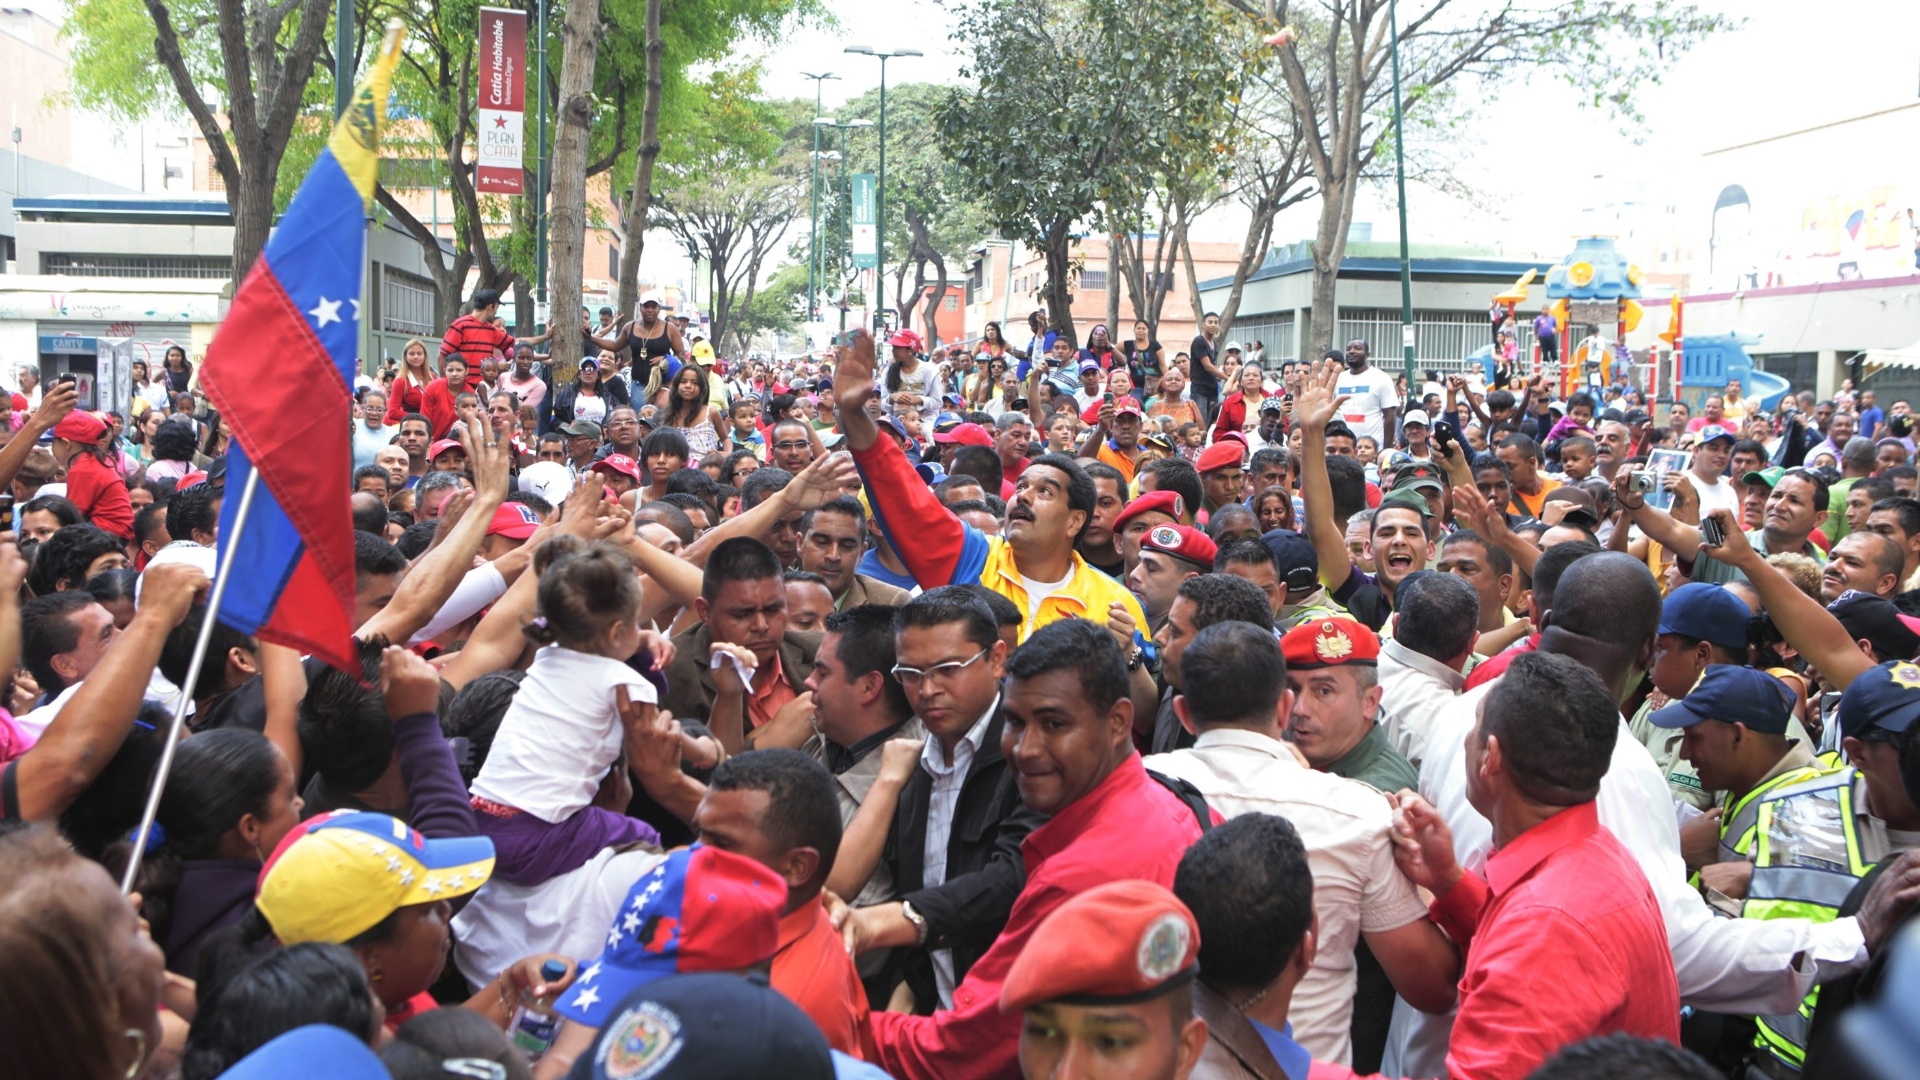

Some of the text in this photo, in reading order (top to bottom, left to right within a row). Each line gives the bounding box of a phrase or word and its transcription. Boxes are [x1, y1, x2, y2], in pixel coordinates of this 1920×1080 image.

[490, 19, 504, 105] Catia Habitable
[505, 56, 513, 77] Digna
[487, 131, 515, 144] PLAN
[483, 144, 518, 158] CATIA
[52, 338, 83, 349] CANTV
[1671, 774, 1690, 784] POLICIA
